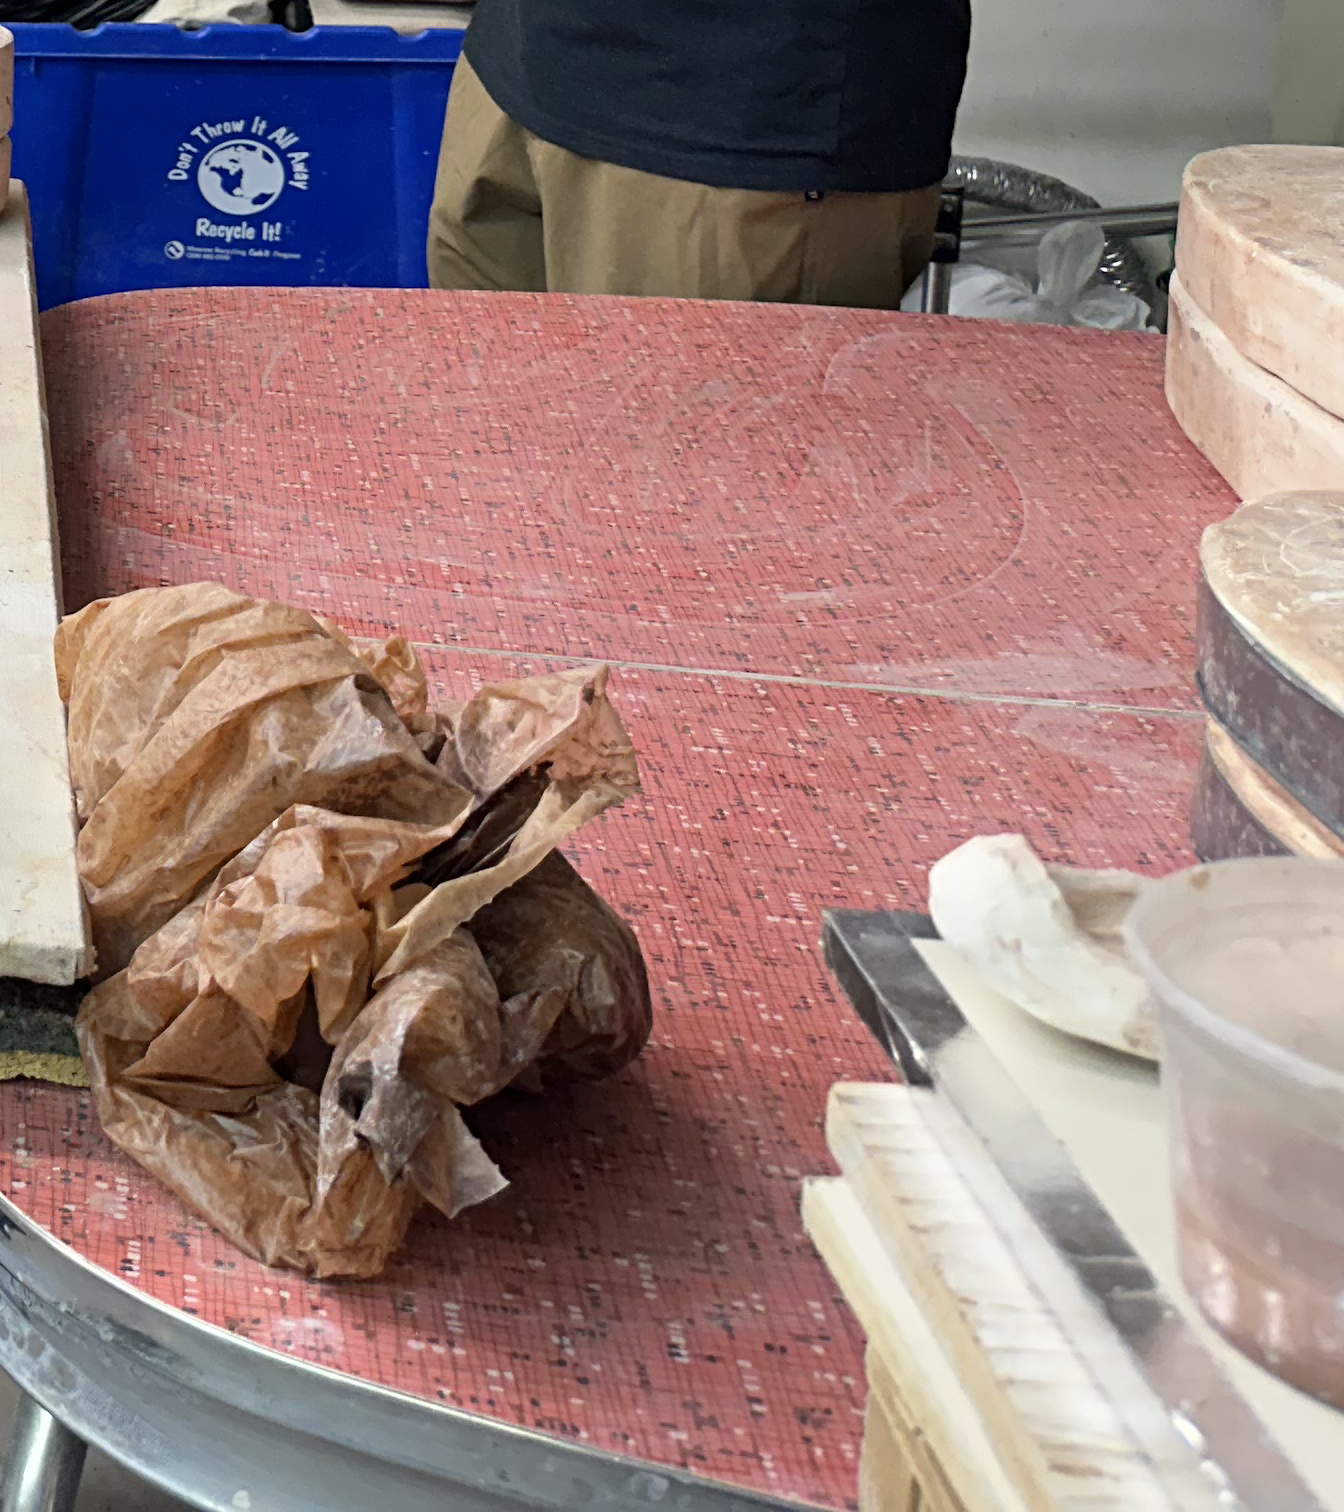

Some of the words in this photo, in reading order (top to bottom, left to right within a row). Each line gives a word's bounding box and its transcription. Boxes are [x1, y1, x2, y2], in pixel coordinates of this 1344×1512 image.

[167, 142, 199, 180] Don't
[190, 119, 245, 144] Throw
[251, 116, 267, 136] It
[267, 126, 300, 150] All
[286, 151, 310, 190] Away
[196, 218, 256, 243] Recycle
[262, 221, 282, 242] It!
